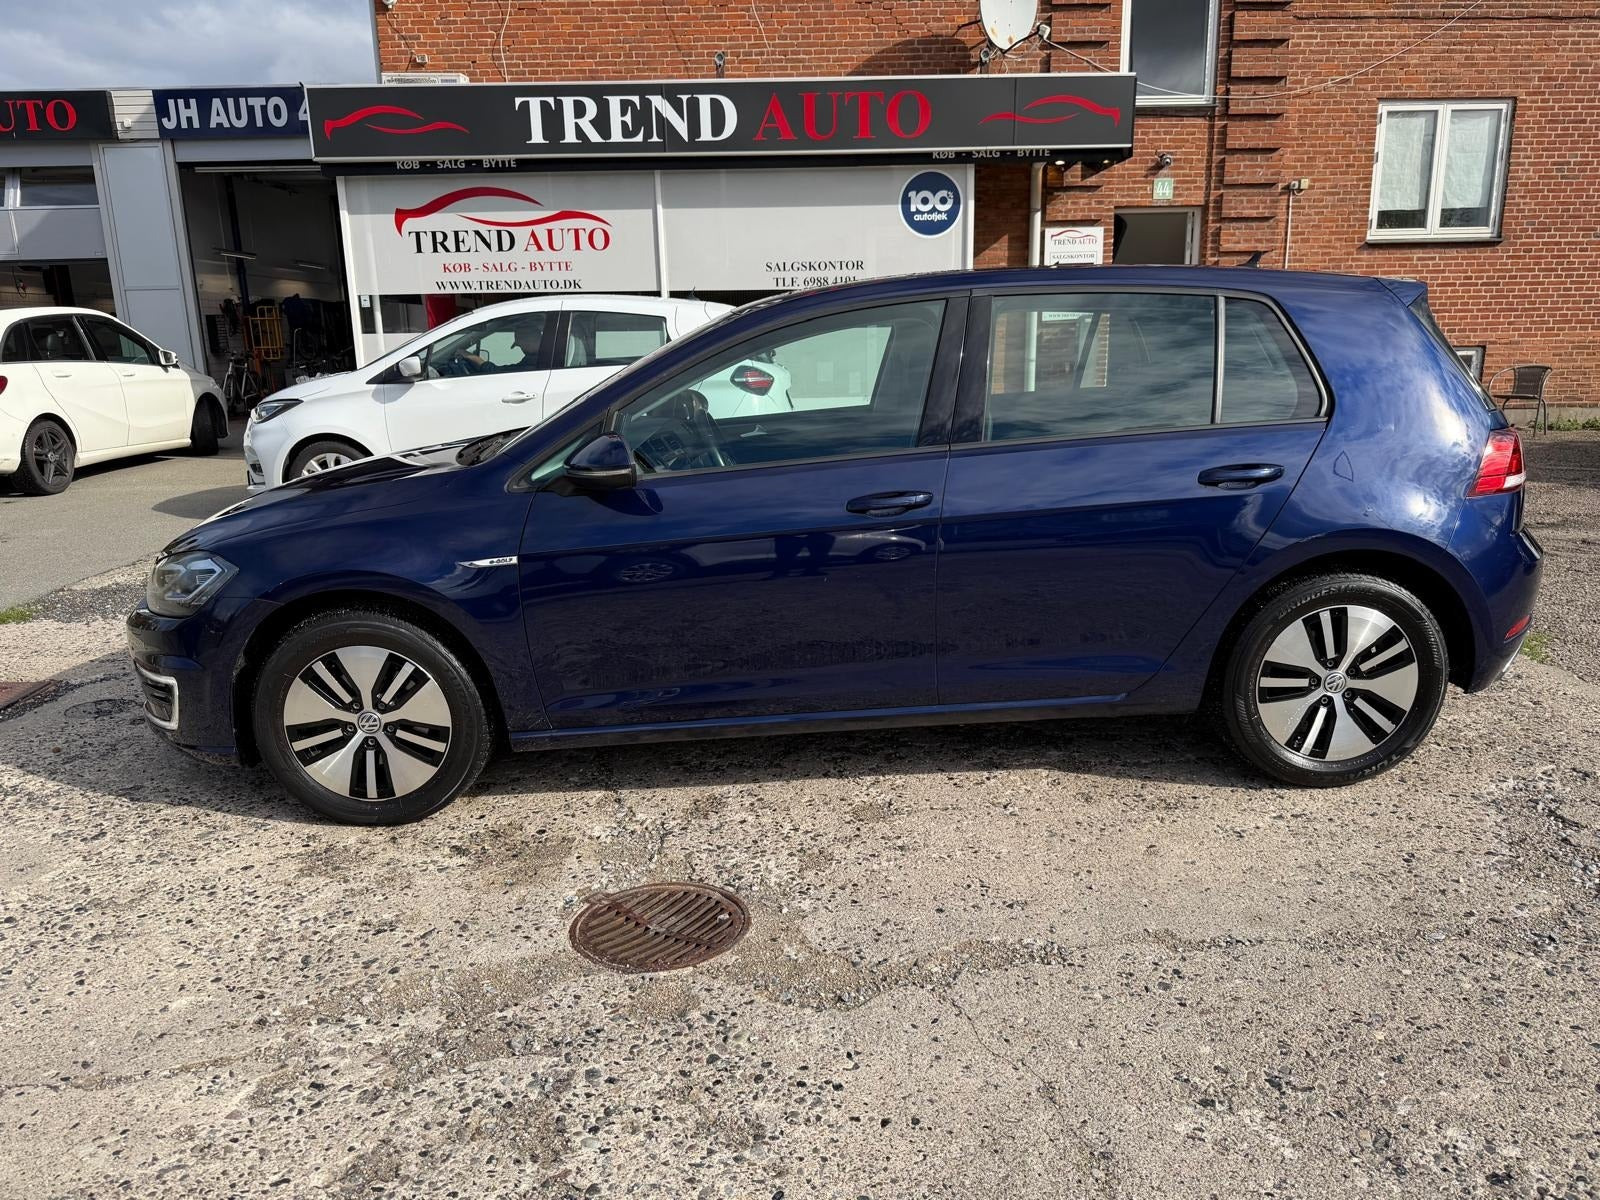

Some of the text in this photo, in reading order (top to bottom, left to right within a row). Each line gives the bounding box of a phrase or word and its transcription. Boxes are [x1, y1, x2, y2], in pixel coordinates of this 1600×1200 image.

[161, 98, 200, 130] JH
[209, 96, 288, 128] AUTO
[514, 89, 933, 145] TREND AUTO
[931, 150, 956, 160] KØB
[972, 149, 1001, 158] SALG
[1017, 148, 1051, 157] BYTTE
[396, 159, 420, 169] KØB
[437, 159, 466, 169] SALG
[483, 157, 517, 168] BYTTE
[1156, 181, 1170, 197] 44
[908, 190, 954, 212] 100%
[913, 211, 948, 222] autotjek
[408, 227, 611, 254] TREND AUTO
[1053, 237, 1098, 246] TREND AUTO
[442, 262, 472, 274] KØB
[482, 262, 518, 273] SALG
[529, 261, 573, 272] BYTTE
[765, 260, 865, 272] SALGSKONTOR
[435, 279, 582, 291] WWW.TRENDAUTO.DK
[773, 276, 800, 288] TLF.
[803, 276, 830, 287] 6988
